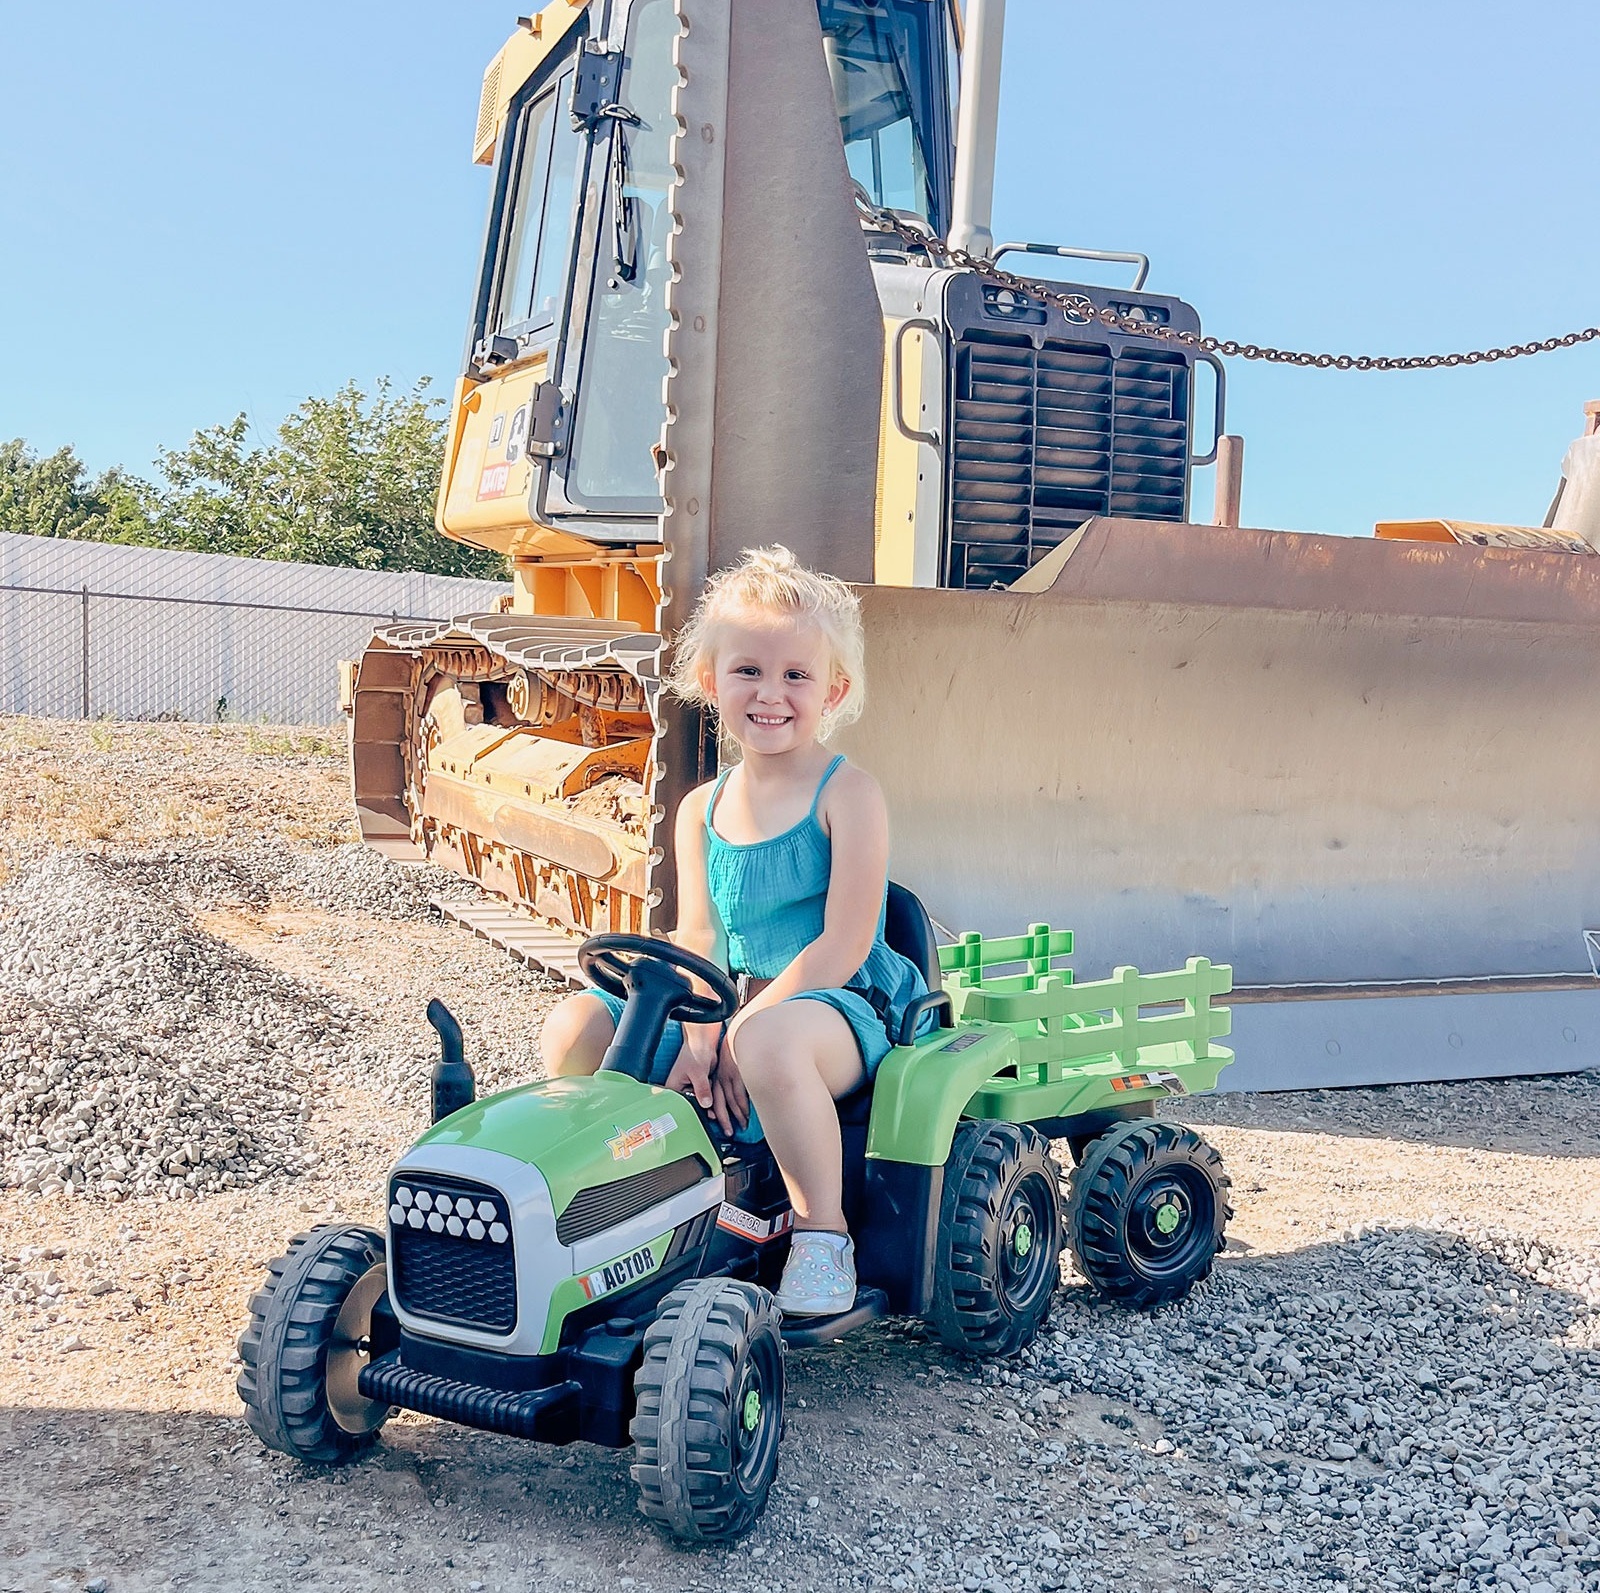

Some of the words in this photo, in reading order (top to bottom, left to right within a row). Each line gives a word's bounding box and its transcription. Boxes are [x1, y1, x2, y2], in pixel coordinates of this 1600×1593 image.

[604, 1120, 654, 1160] FAST
[721, 1204, 760, 1233] TRACTOR
[578, 1247, 655, 1299] TRACTOR
